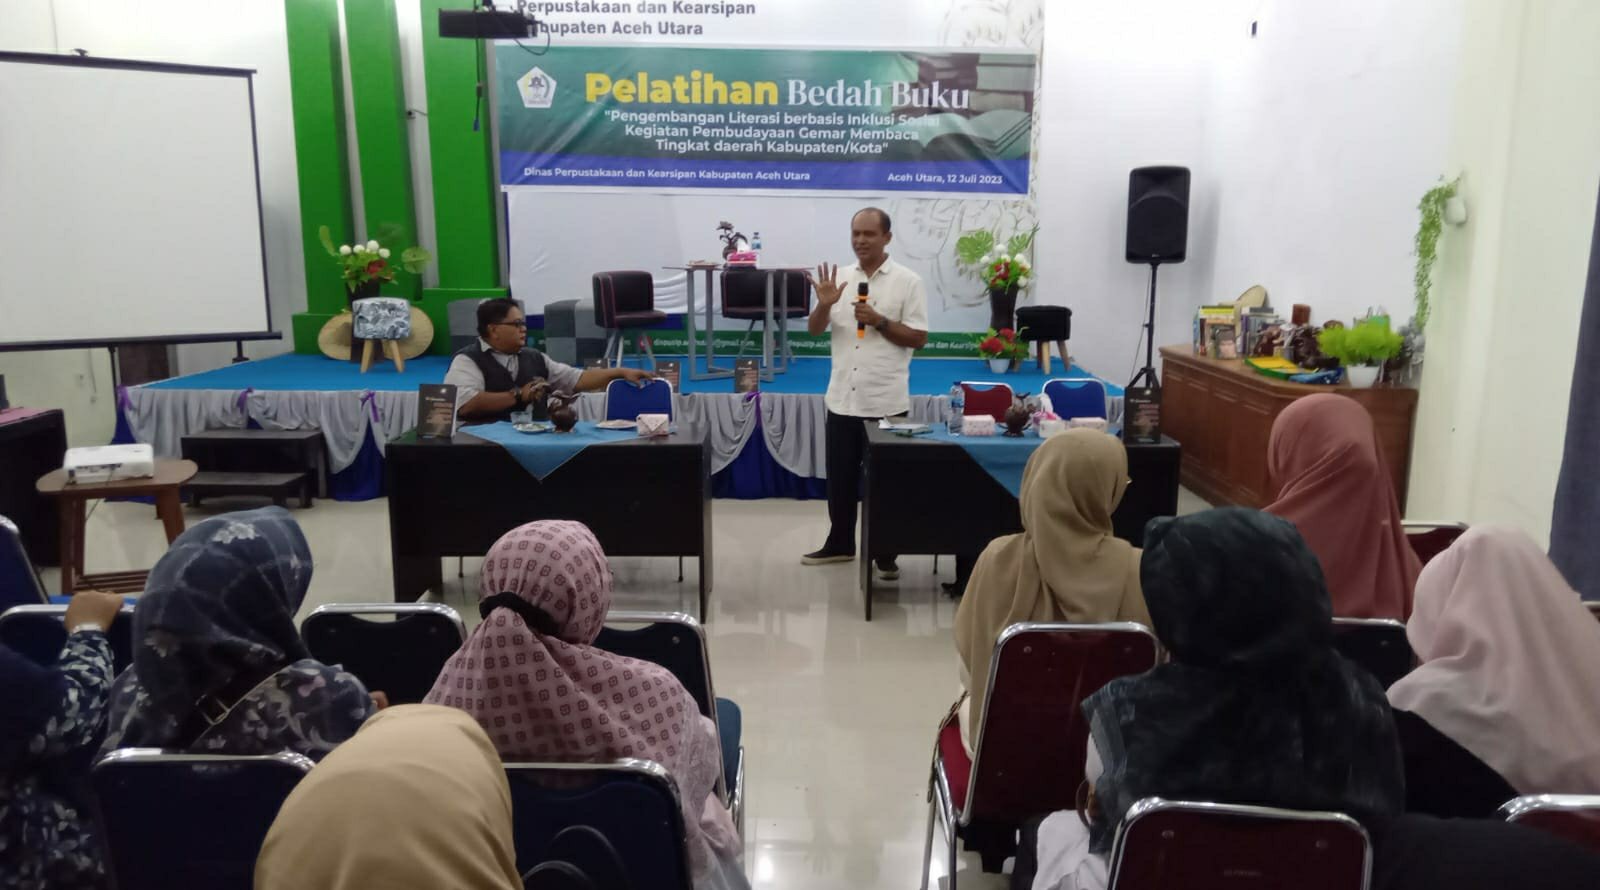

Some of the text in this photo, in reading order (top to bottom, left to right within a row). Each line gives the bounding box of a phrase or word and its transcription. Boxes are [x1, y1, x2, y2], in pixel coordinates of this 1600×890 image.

[517, 0, 756, 17] Perpustakaan dan Kearsipan
[536, 21, 703, 37] bupaten Aceh Utara
[585, 70, 969, 109] Pelatihan Bedah Buku
[604, 109, 725, 125] "Pengembangan
[728, 111, 780, 124] Literasi
[783, 112, 844, 125] berbasis
[847, 113, 895, 126] Inklusi
[624, 124, 919, 141] Kegiatan Pembudayaan Gemar Membaca
[655, 138, 889, 156] Tingkat daerah Kabupaten/Kota"
[523, 167, 811, 181] Dinas Perpustakaan dan Kearsipan Kabupaten Aceh Utara
[887, 173, 1003, 184] Aceh Utara, 12 Juli 2023
